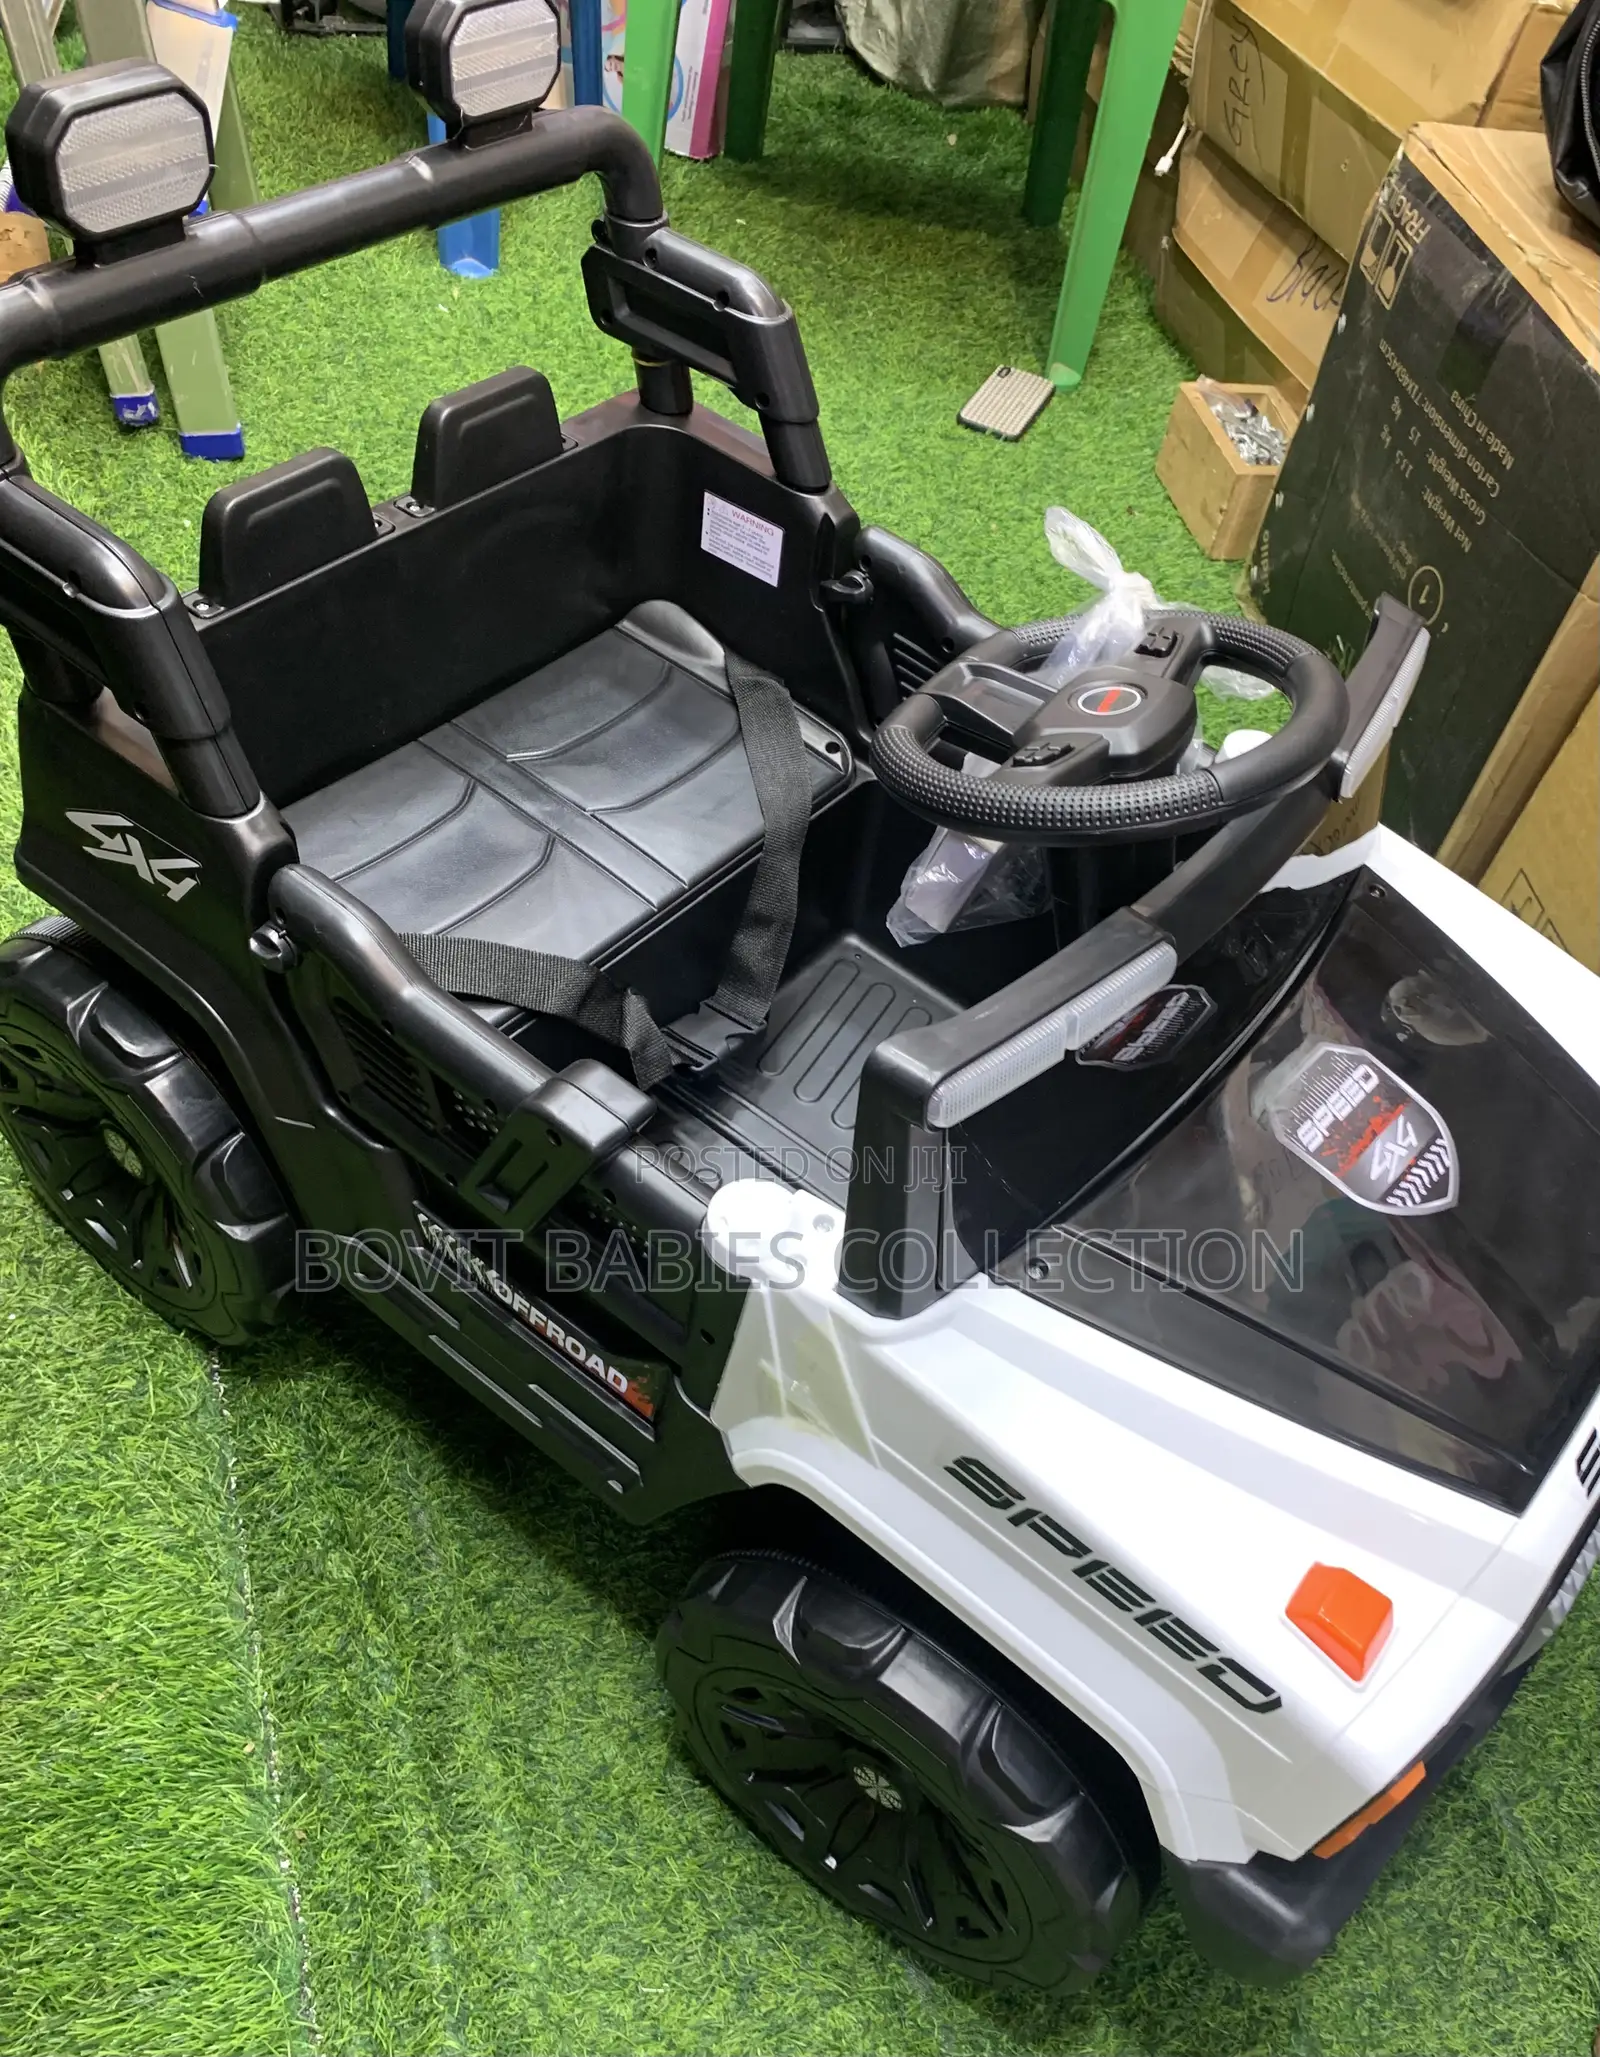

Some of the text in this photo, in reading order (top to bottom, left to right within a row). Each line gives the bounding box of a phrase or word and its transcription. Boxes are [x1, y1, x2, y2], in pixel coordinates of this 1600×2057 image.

[1380, 424, 1392, 449] kg
[1422, 397, 1468, 460] dimension:
[1451, 390, 1515, 471] Made in China
[1391, 396, 1486, 526] Gross Weight: 15 kg
[1466, 455, 1500, 498] Carton
[731, 509, 774, 537] WARNING
[1421, 485, 1455, 533] Weight:
[1453, 526, 1472, 553] Net
[1296, 1063, 1380, 1153] SPEED
[493, 1279, 629, 1394] OFFROAD
[943, 1455, 1282, 1714] SPEED
